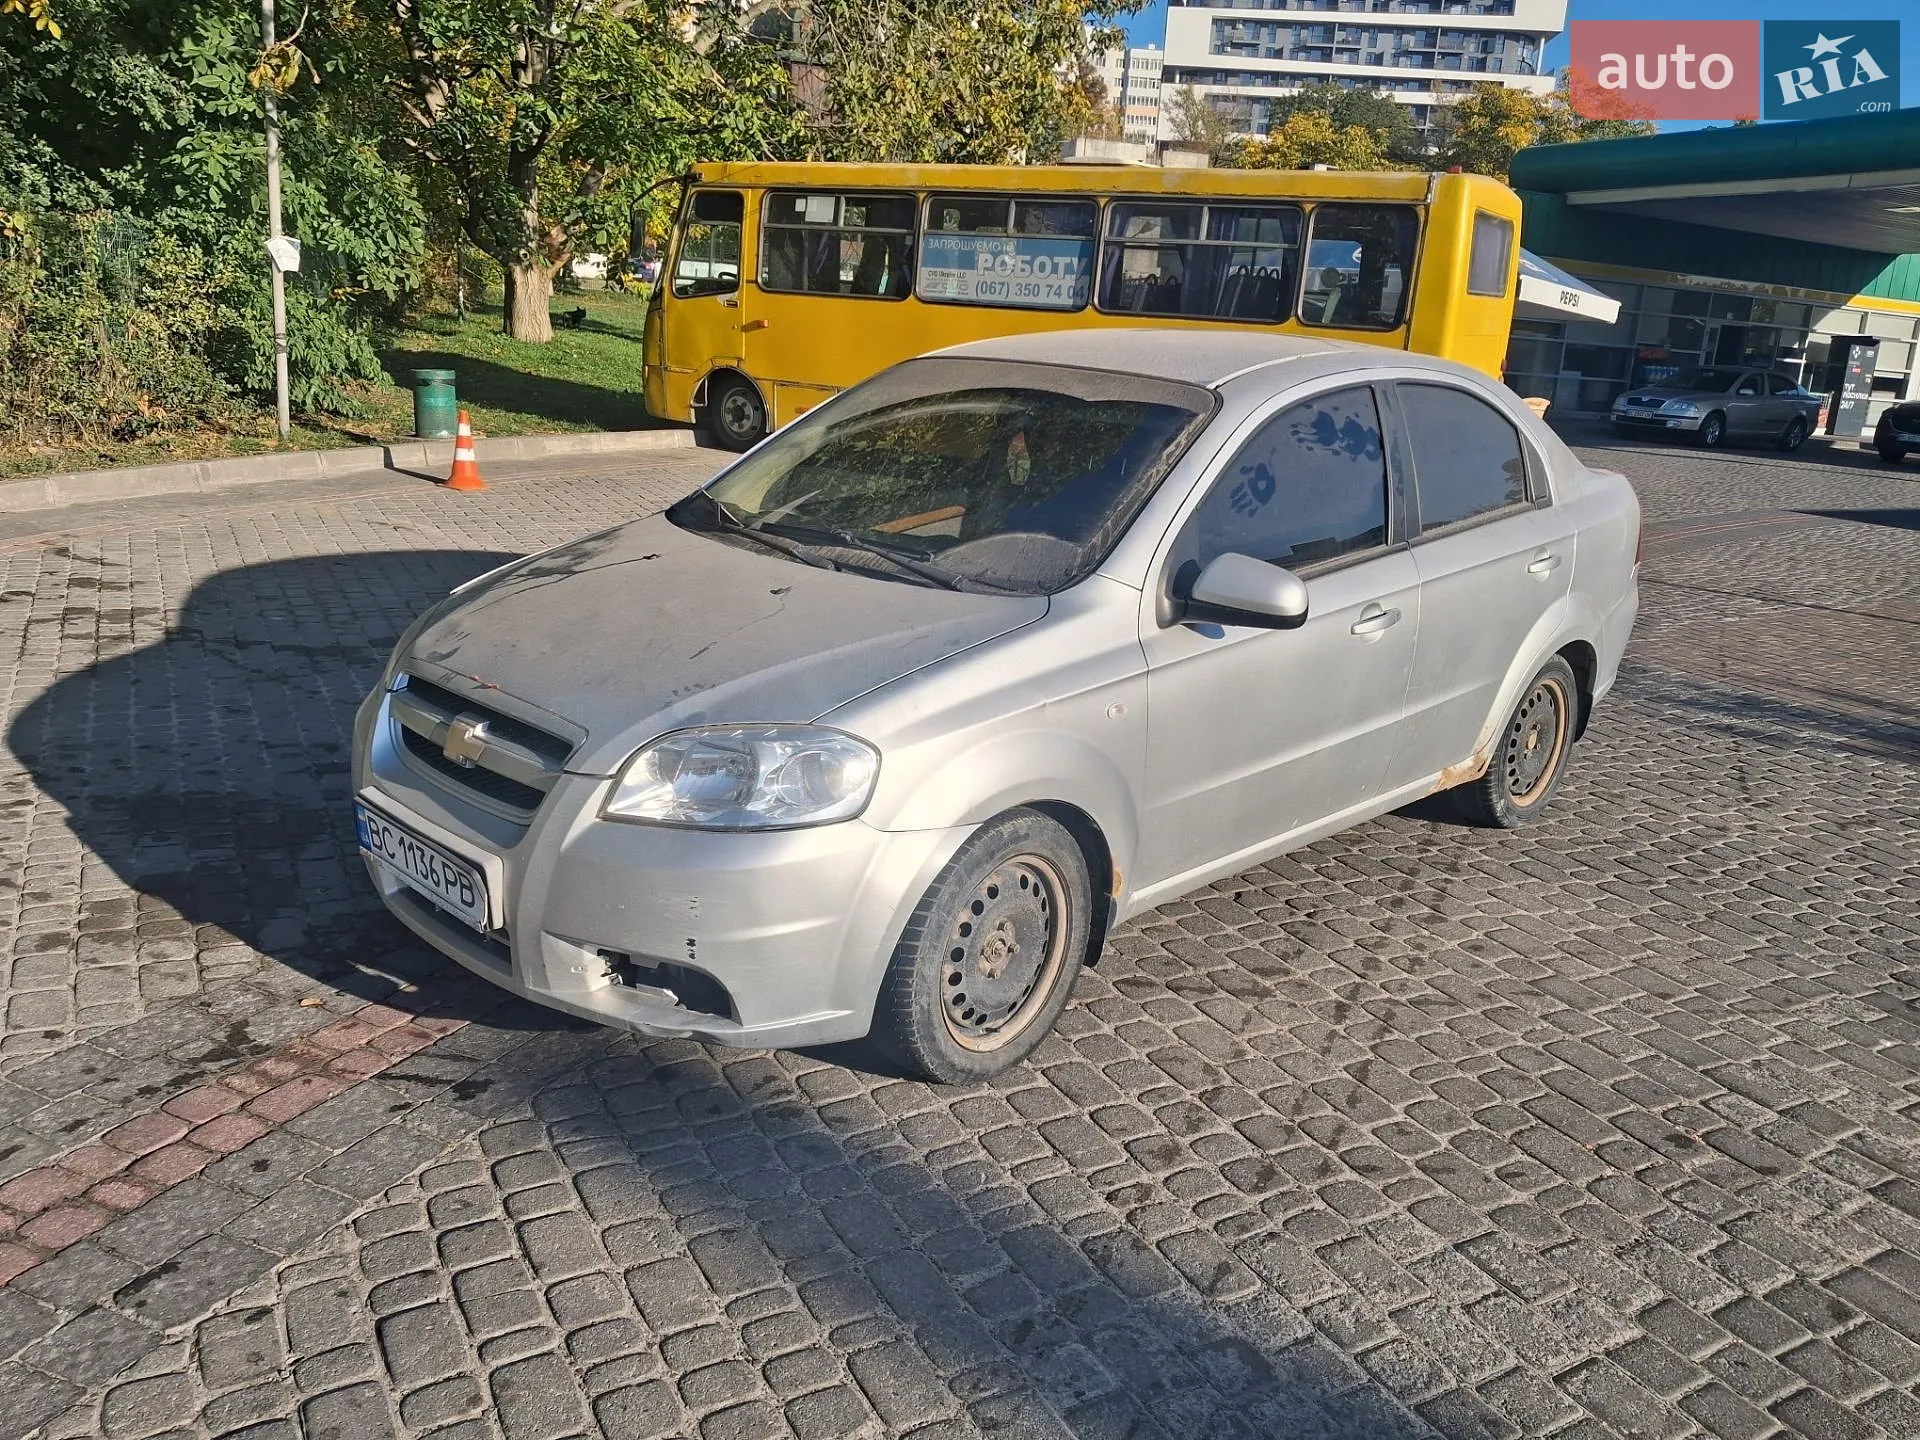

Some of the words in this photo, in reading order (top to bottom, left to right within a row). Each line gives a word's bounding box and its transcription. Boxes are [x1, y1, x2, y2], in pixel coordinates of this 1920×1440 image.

[928, 238, 1001, 251] ЗАПРОШУЄМО
[976, 252, 1088, 281] РОБОТУ
[975, 279, 1010, 299] (067)
[1015, 282, 1040, 298] 350
[1045, 284, 1063, 299] 74
[1067, 284, 1085, 300] 04
[1560, 290, 1580, 308] PEPSI
[367, 815, 396, 859] BC
[398, 836, 441, 888] 1136
[441, 861, 476, 908] PB
